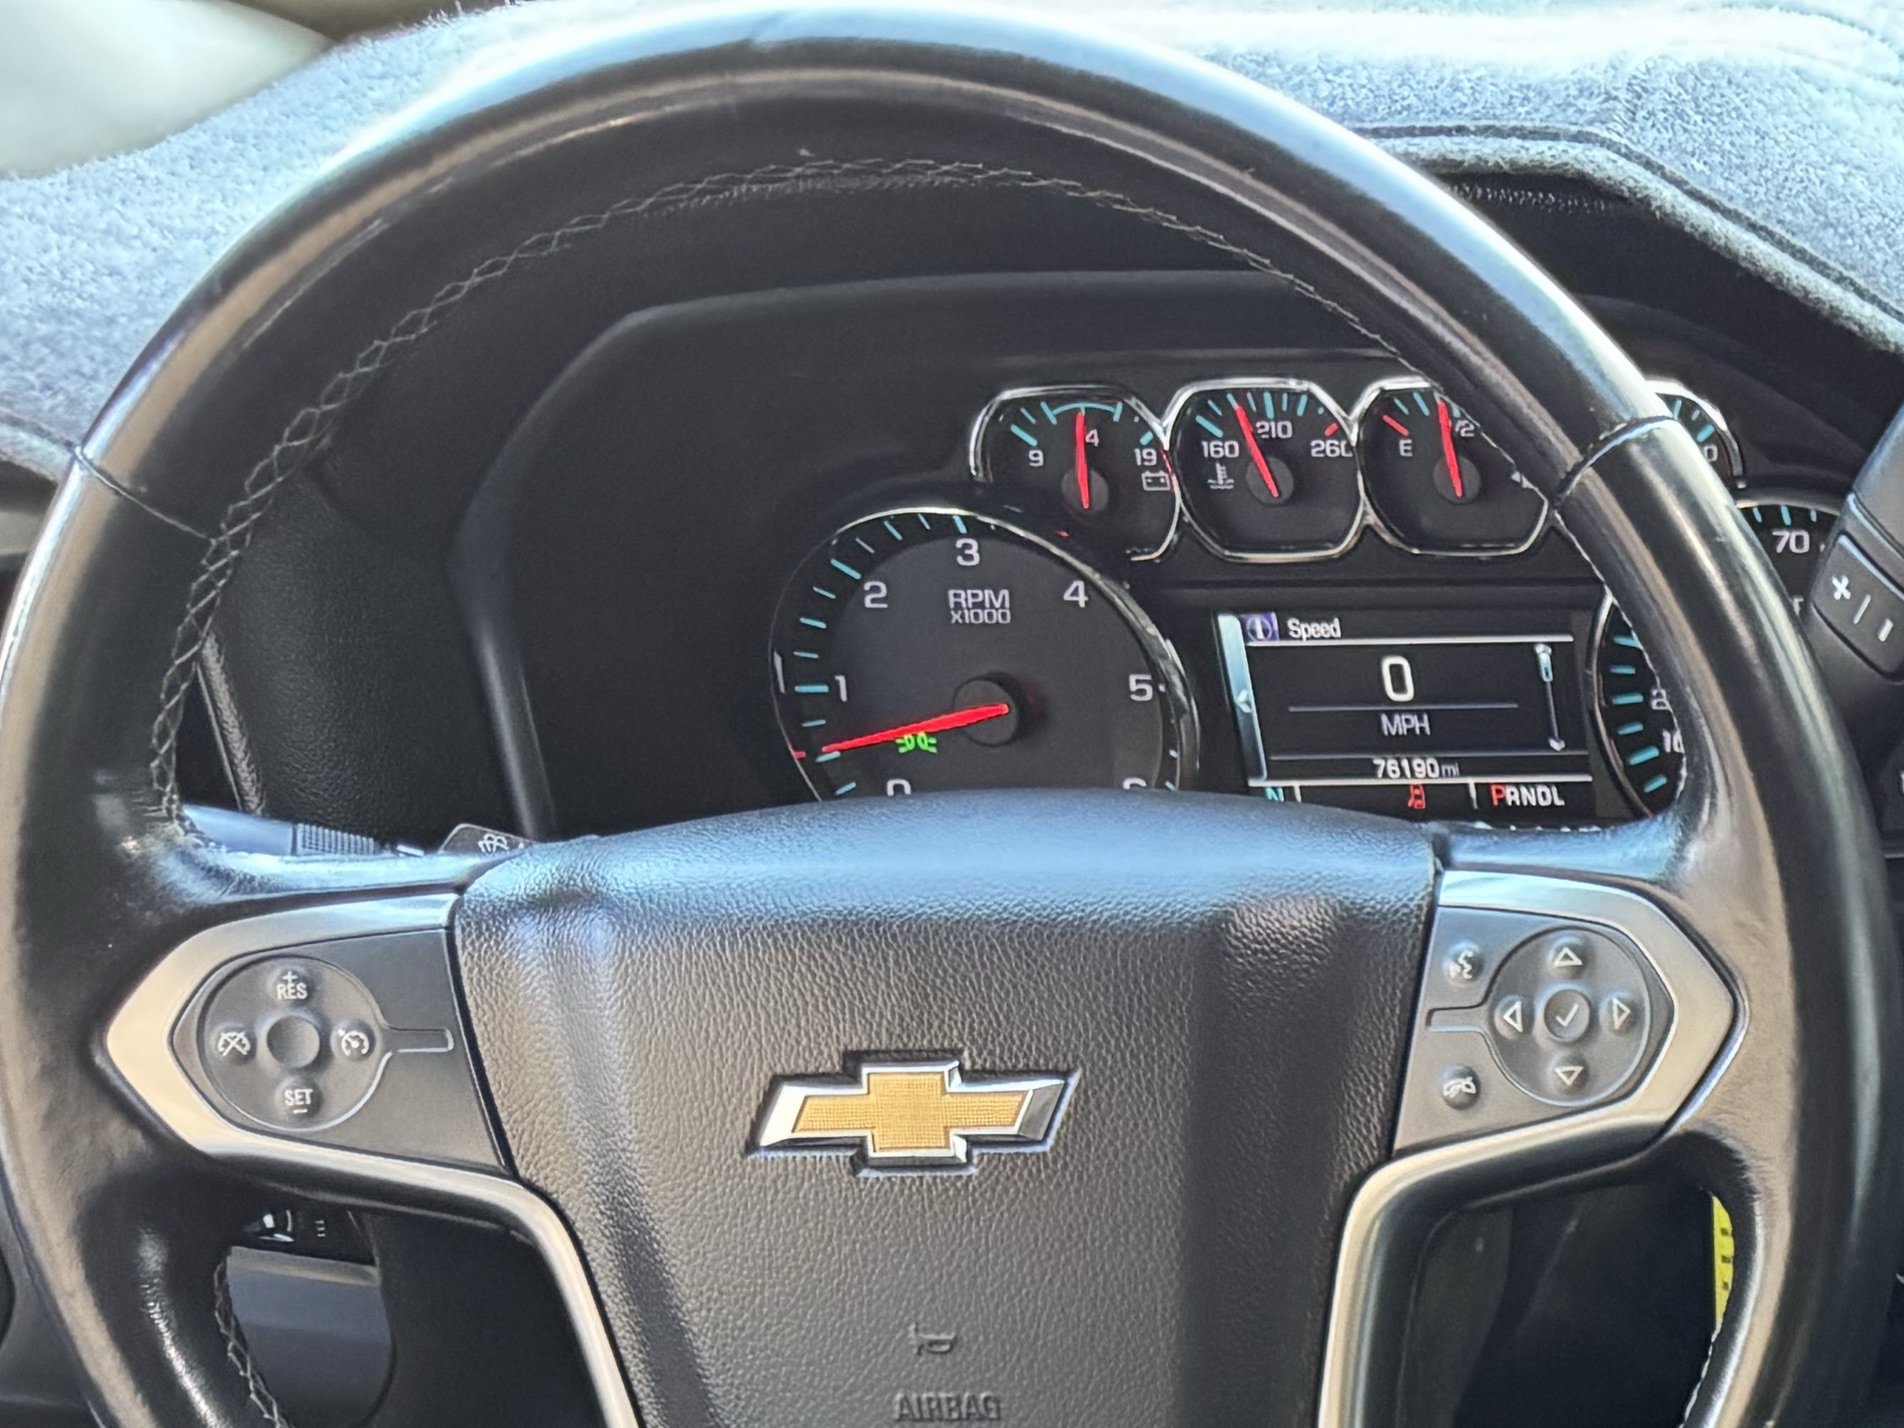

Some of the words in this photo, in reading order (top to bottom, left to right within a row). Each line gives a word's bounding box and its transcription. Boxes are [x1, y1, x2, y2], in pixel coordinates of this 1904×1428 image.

[1255, 420, 1293, 438] 210
[1028, 450, 1044, 467] 9
[1134, 448, 1157, 466] 19
[1202, 440, 1239, 458] 160
[1400, 438, 1413, 457] E
[955, 538, 981, 567] 3
[1772, 530, 1810, 553] 70
[863, 581, 888, 608] 2
[948, 589, 1010, 609] RPM
[1063, 580, 1088, 608] 4
[1287, 617, 1342, 641] Speed
[835, 674, 848, 702] 1
[1128, 674, 1153, 701] 5
[1381, 655, 1415, 702] 0
[1381, 713, 1431, 736] MPH
[1372, 758, 1439, 779] 76190
[277, 982, 308, 1001] RES
[284, 1088, 314, 1106] SET
[893, 1391, 1002, 1421] AIRBAG
